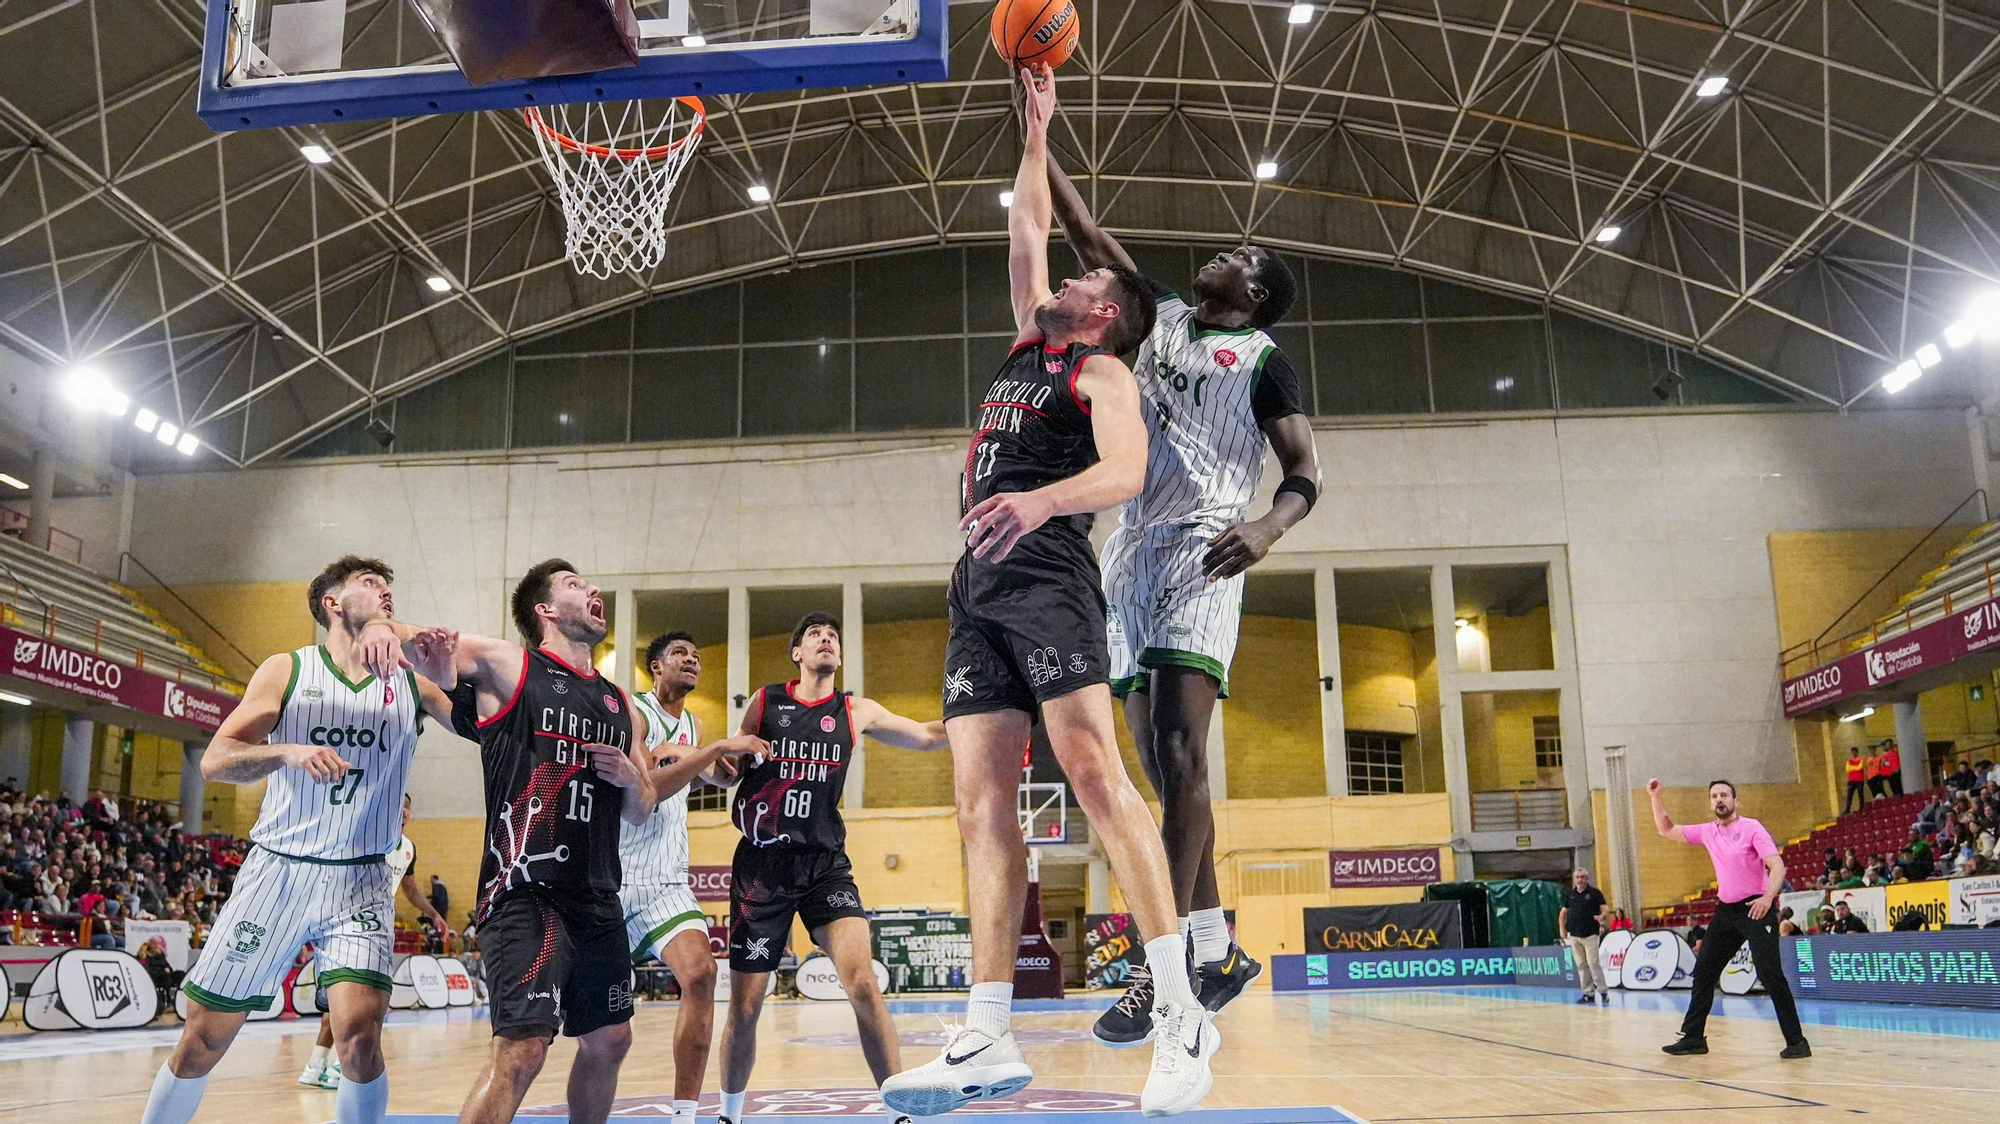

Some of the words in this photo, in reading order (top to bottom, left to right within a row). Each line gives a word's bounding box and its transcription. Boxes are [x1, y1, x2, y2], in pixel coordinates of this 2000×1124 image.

[1032, 2, 1074, 45] Wilson
[984, 378, 1051, 409] CÍRCULO
[979, 402, 1024, 434] GIJÓN
[40, 643, 122, 690] IMDECO
[1796, 666, 1841, 699] IMDECO
[310, 725, 376, 748] coto
[771, 737, 841, 762] CÍRCULO
[779, 760, 828, 783] GIJÓN
[565, 779, 594, 823] 15
[784, 788, 812, 819] 68
[688, 873, 732, 889] DECO
[1357, 856, 1436, 875] IMDECO
[1348, 958, 1456, 980] SEGUROS
[1462, 957, 1515, 976] PARA
[1543, 957, 1561, 975] VIDA
[1829, 951, 1926, 982] SEGUROS
[1929, 951, 2000, 984] PARA
[92, 975, 123, 1002] RG3
